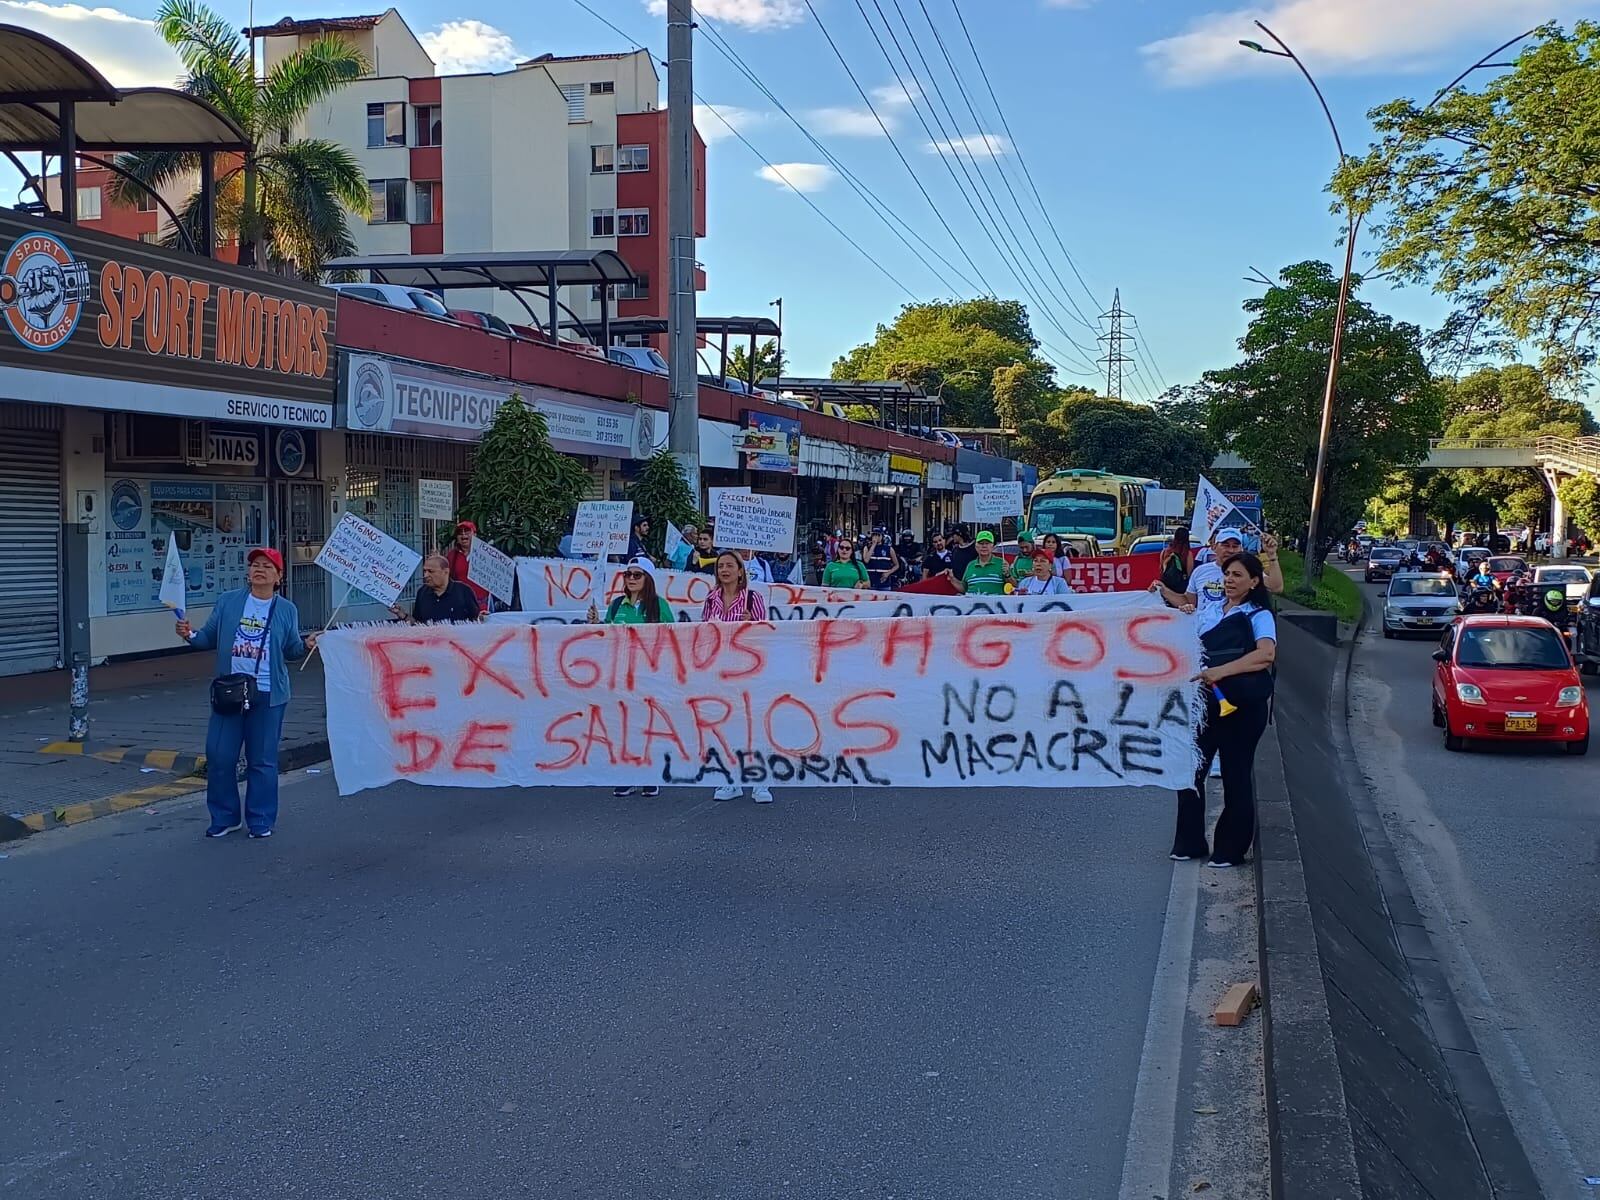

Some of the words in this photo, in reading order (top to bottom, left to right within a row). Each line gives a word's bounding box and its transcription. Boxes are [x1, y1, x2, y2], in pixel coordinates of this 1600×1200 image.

[15, 238, 60, 261] SPORT
[22, 315, 73, 344] MOTORS
[97, 260, 210, 360] SPORT
[214, 286, 329, 379] MOTORS
[227, 400, 280, 419] SERVICIO
[282, 406, 328, 424] TECNICO
[720, 501, 767, 515] ESTABILIDAD
[545, 564, 592, 606] NO
[365, 622, 775, 718] EXIGIMOS
[814, 615, 1185, 684] PAGOS
[942, 679, 1018, 727] NO
[1047, 680, 1089, 725] A
[1110, 684, 1190, 729] LA
[394, 721, 511, 773] DE
[535, 690, 900, 770] SALARIOS
[661, 747, 891, 786] LABORAL
[921, 727, 1163, 780] MASACRE
